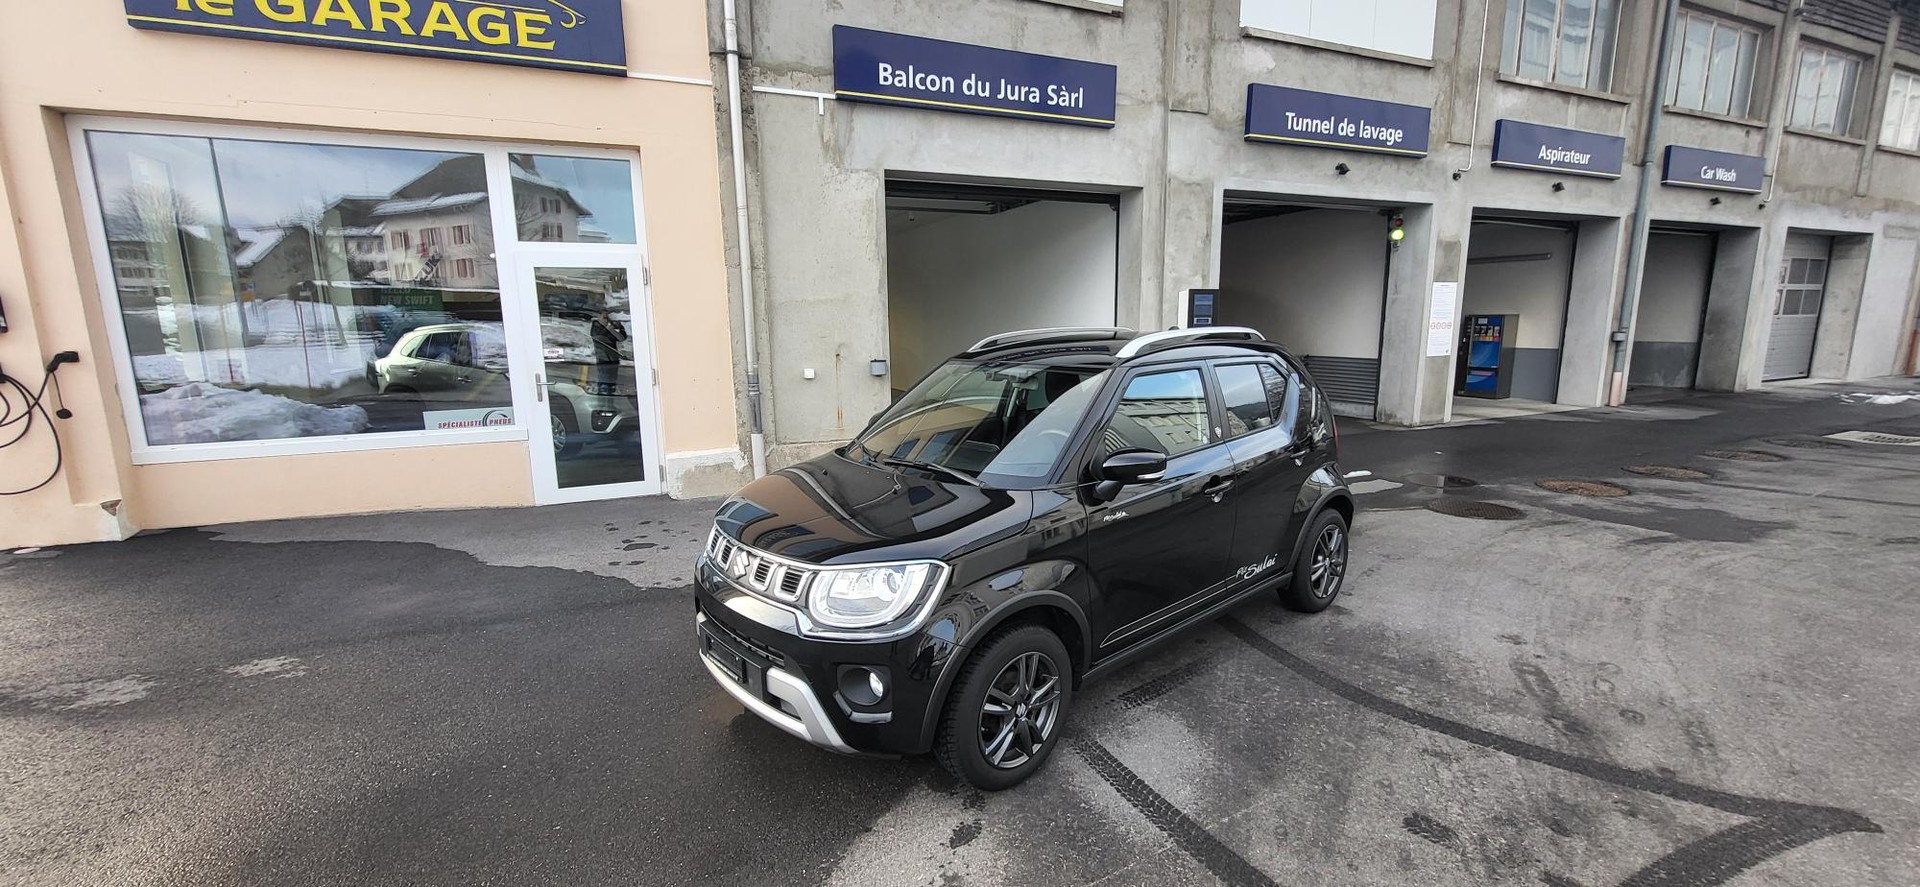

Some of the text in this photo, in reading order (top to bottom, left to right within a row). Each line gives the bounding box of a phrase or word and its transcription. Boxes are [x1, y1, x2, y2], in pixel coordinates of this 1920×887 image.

[253, 0, 558, 50] GARAGE
[878, 62, 1084, 108] Balcon du Jura Sàrl
[1285, 111, 1403, 146] Tunnel de lavage
[1538, 144, 1591, 165] Aspirateur
[1701, 165, 1737, 182] Car Wash
[405, 294, 434, 305] SWIFT
[489, 417, 512, 426] PNEUS
